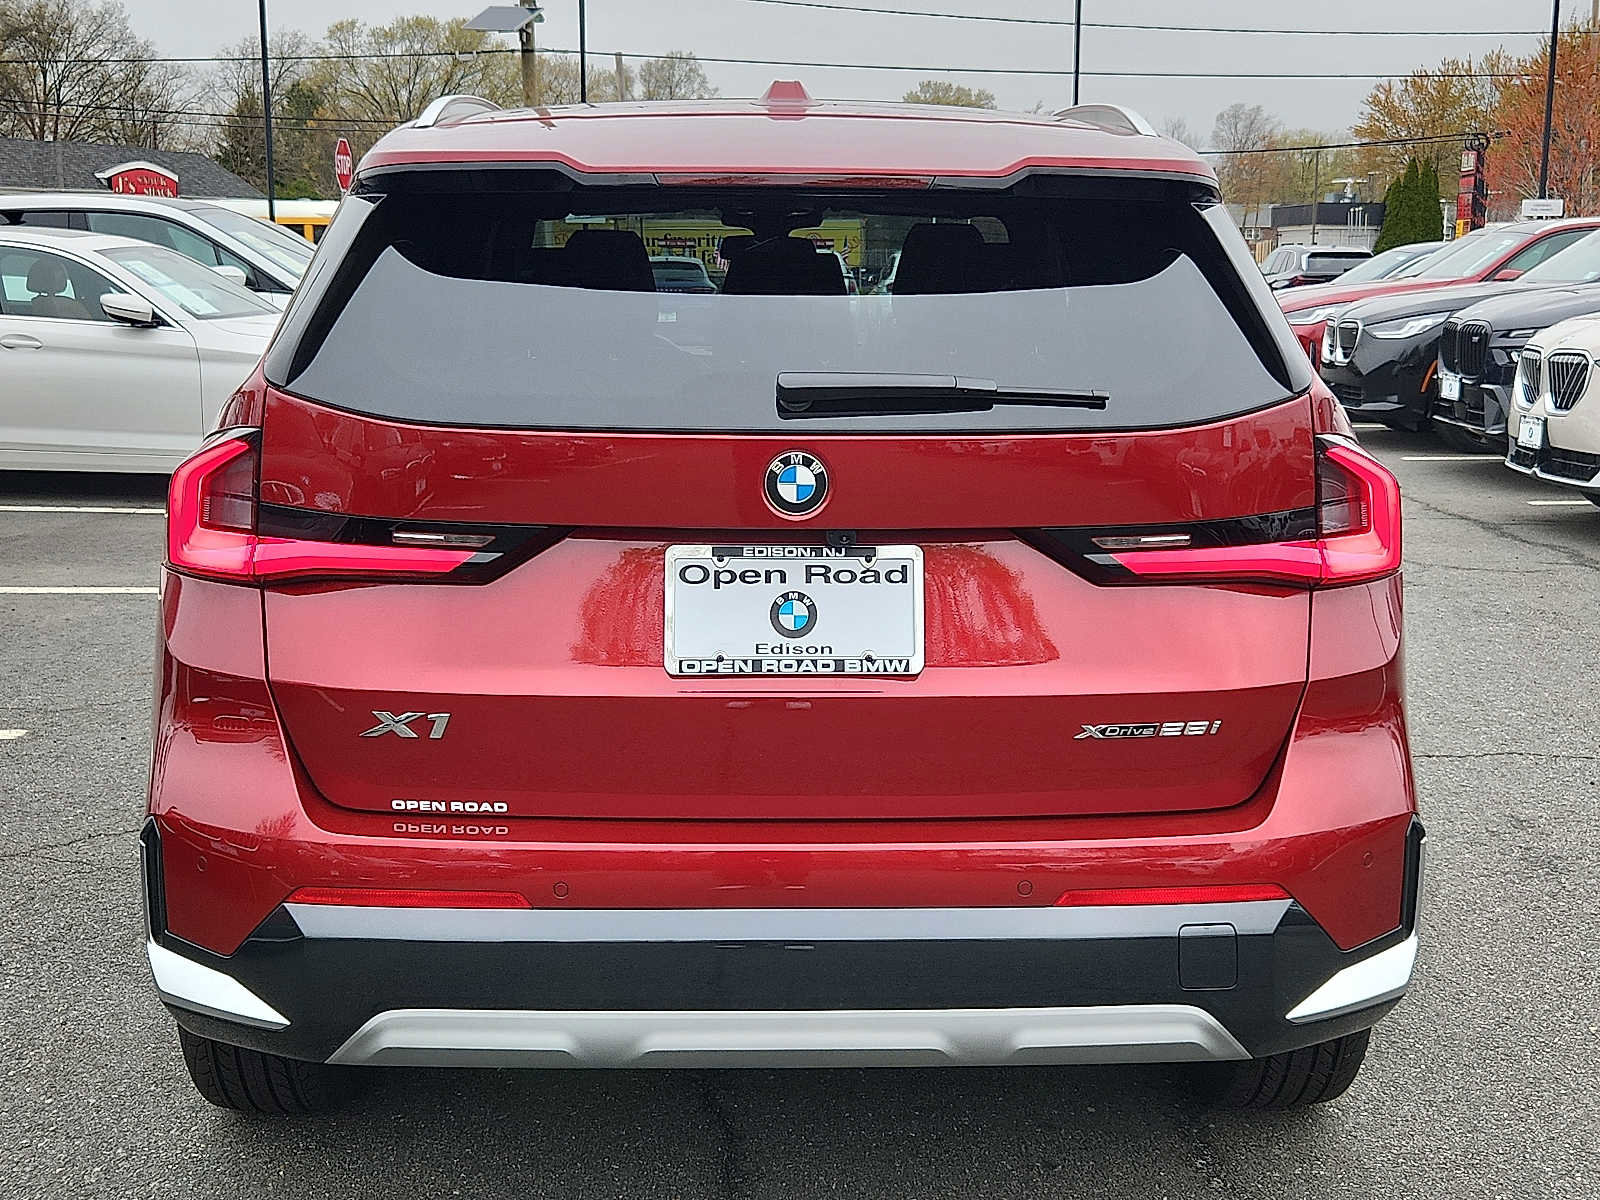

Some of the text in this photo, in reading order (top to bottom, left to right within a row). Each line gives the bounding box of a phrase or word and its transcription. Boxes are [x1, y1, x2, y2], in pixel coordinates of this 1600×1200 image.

[336, 154, 351, 176] STOP
[771, 453, 824, 475] BMW
[742, 547, 846, 558] EDISON, NJ
[678, 564, 908, 590] Open Road
[775, 592, 813, 607] BMW
[755, 643, 833, 656] Edison
[681, 659, 909, 674] OPEN ROAD BMW
[358, 710, 451, 739] X1
[391, 799, 509, 813] OPEN ROAD
